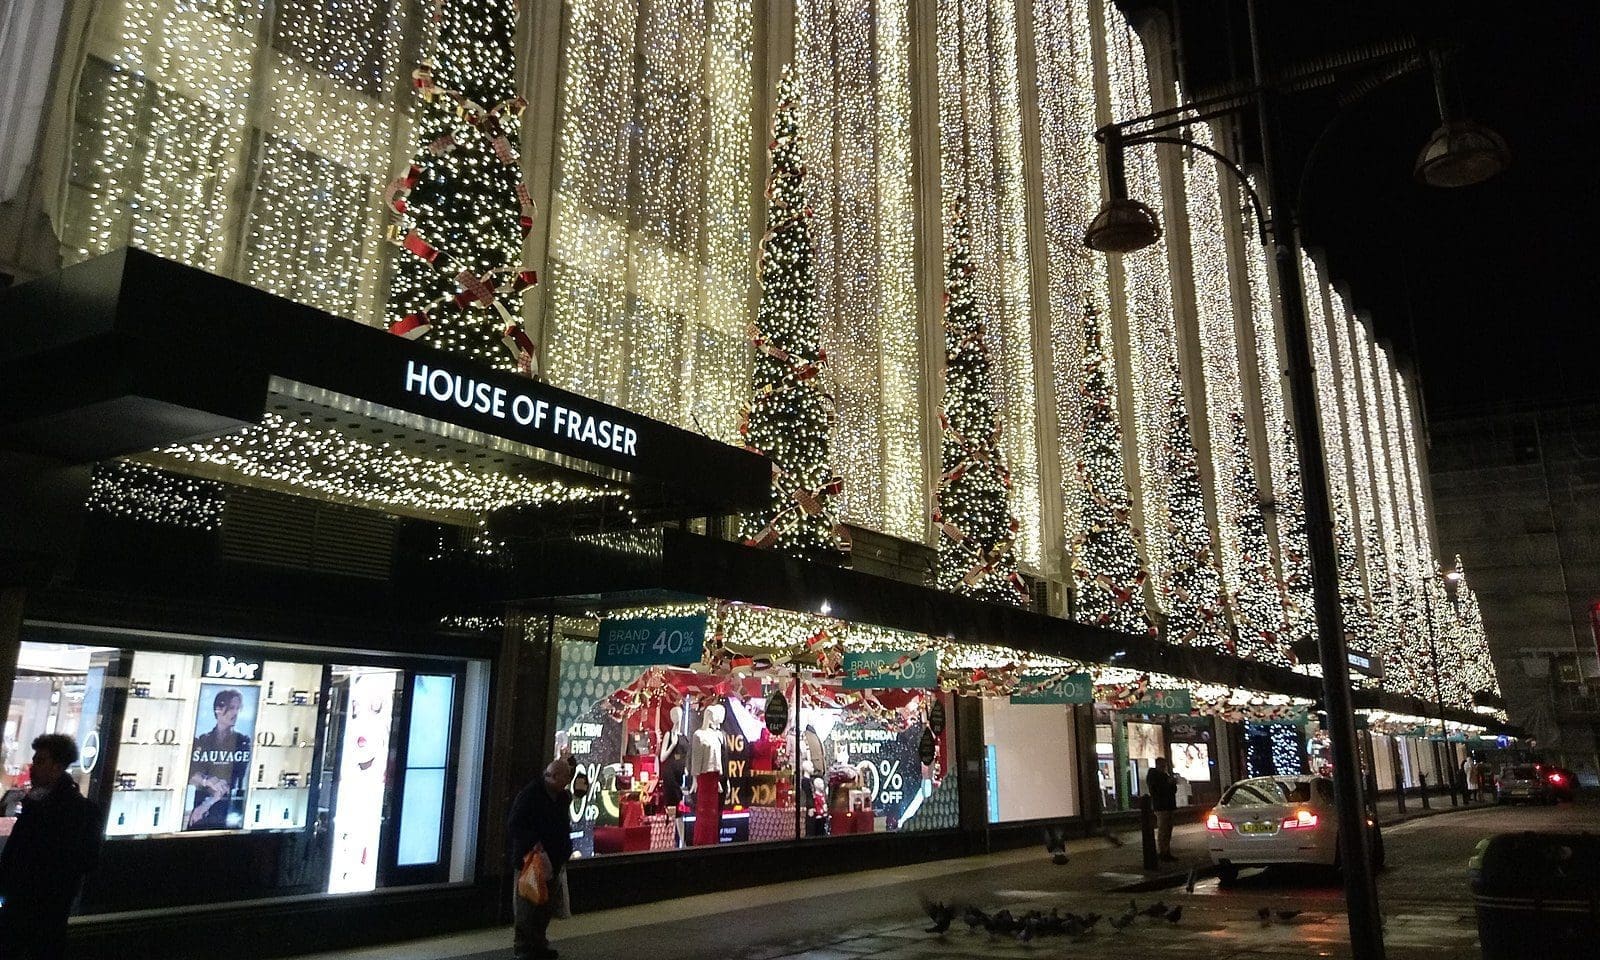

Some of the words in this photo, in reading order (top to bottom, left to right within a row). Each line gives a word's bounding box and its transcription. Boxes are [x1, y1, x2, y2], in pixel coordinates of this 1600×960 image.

[405, 360, 507, 419] HOUSE
[512, 394, 549, 429] OF
[553, 405, 638, 457] FRASER
[609, 630, 650, 641] BRAND
[652, 629, 694, 655] 40%
[608, 643, 646, 655] EVENT
[206, 655, 259, 680] Dior
[851, 659, 885, 671] BRAND
[582, 723, 603, 737] FRIDAY
[831, 729, 863, 741] BLACK
[864, 730, 898, 741] FRIDAY
[571, 740, 592, 754] EVENT
[850, 743, 881, 753] EVENT
[192, 750, 250, 762] SAUVAGE
[881, 791, 903, 804] OFF
